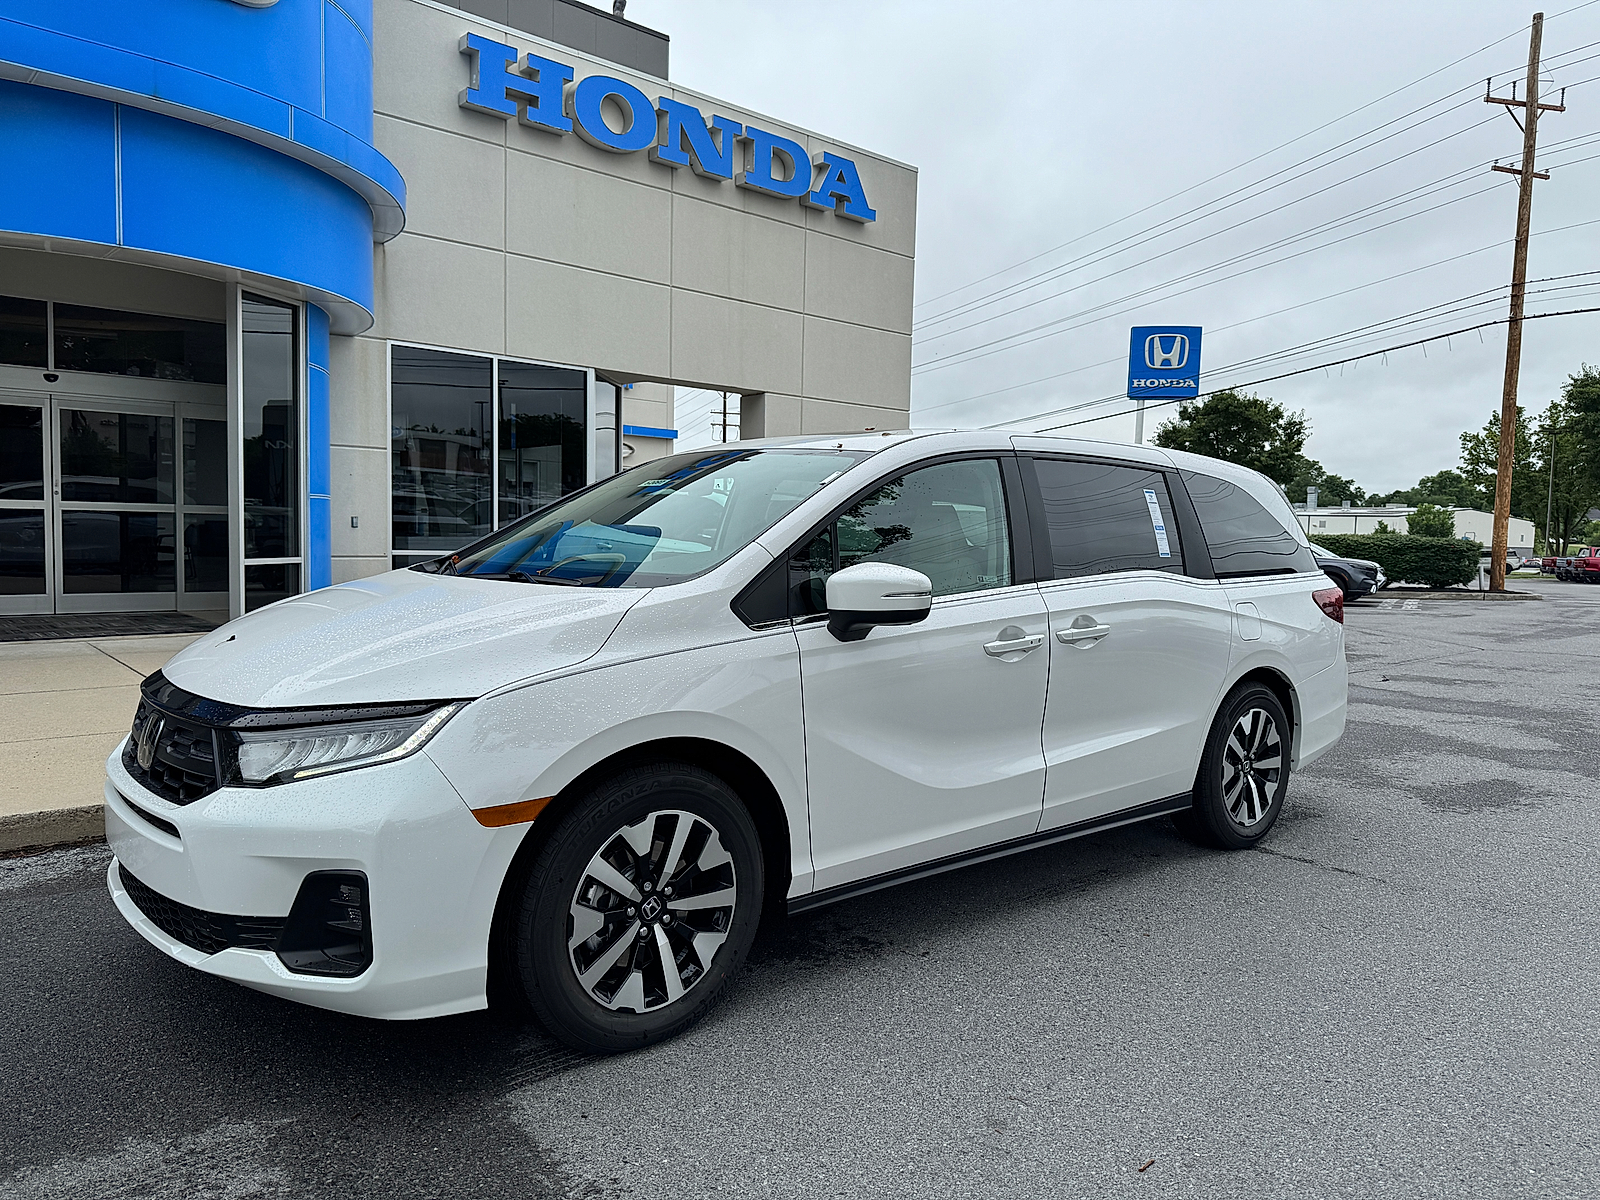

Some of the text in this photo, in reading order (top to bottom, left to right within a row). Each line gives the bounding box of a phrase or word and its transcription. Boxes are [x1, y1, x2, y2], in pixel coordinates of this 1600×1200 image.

[460, 32, 876, 223] HONDA
[1131, 378, 1197, 388] HONDA
[566, 779, 662, 851] TURANZA
